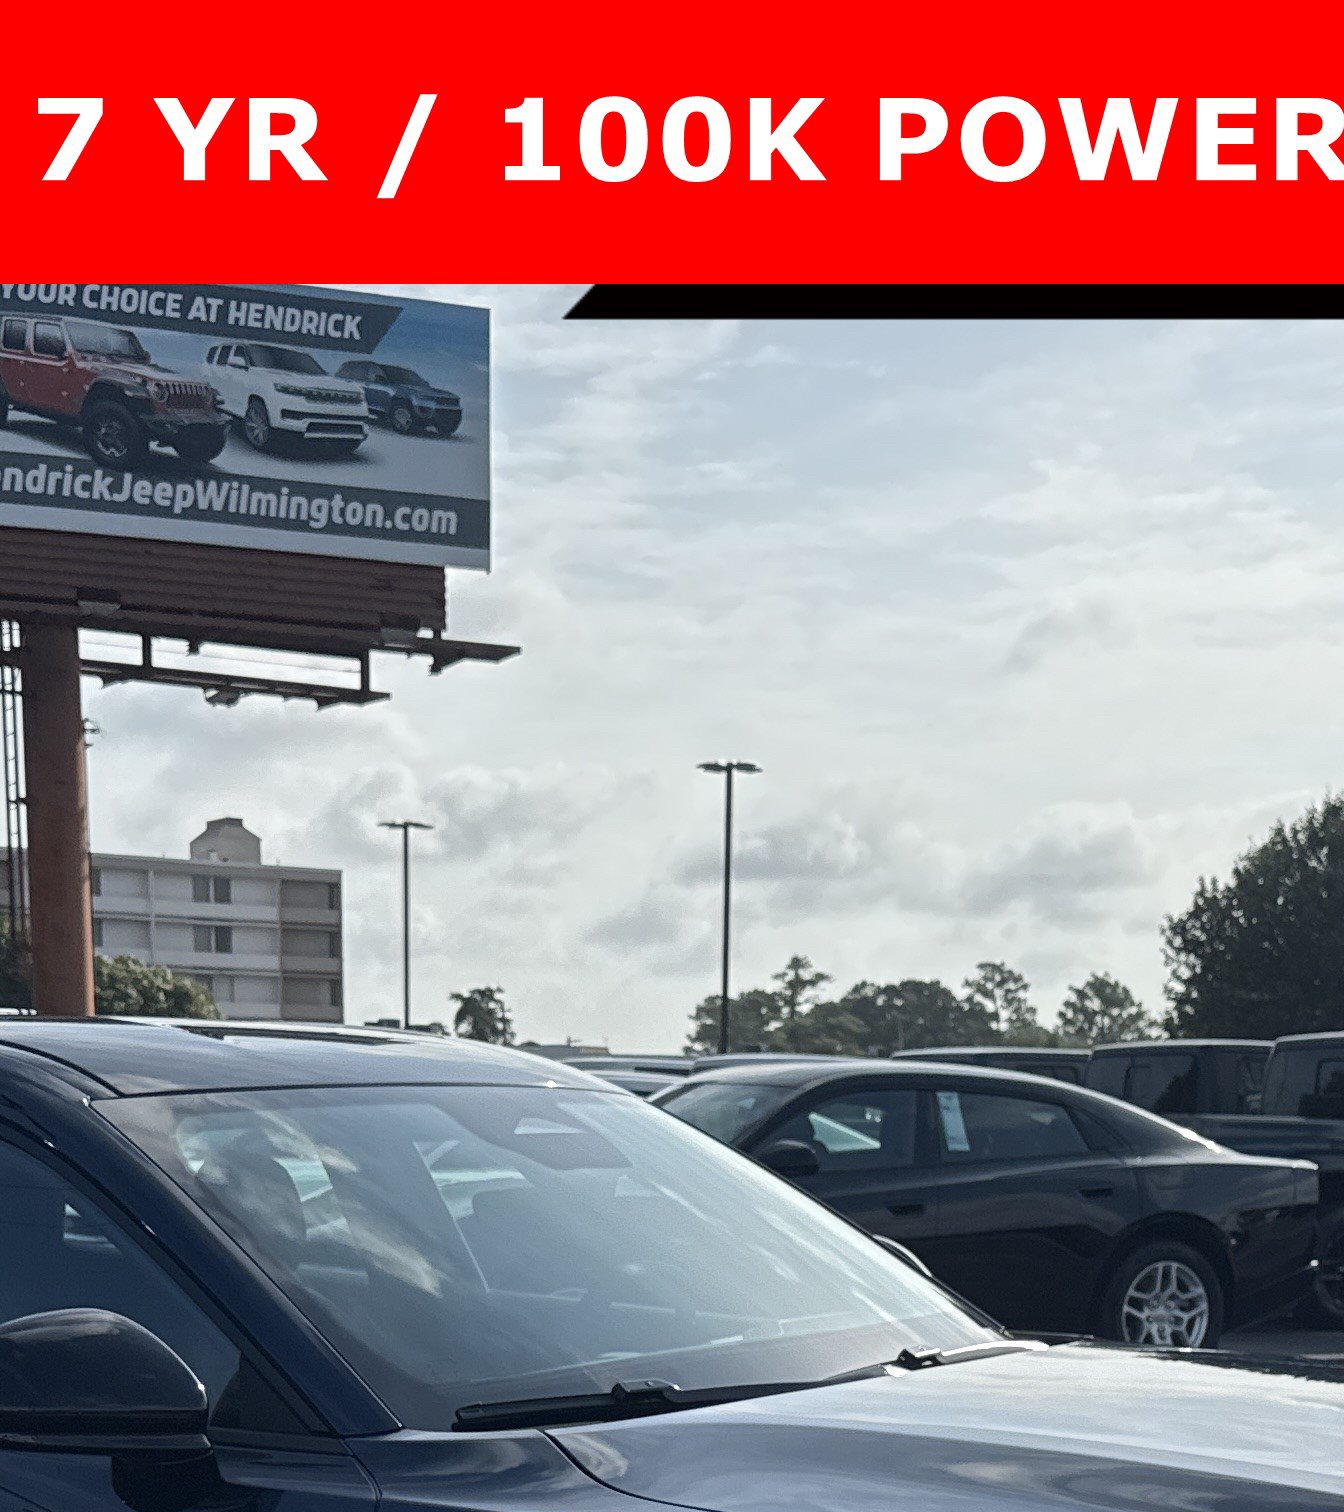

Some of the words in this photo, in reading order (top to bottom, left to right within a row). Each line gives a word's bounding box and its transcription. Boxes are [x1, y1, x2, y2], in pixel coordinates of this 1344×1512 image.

[1, 284, 75, 306] YOUR
[82, 285, 183, 319] CHOICE
[187, 295, 224, 323] AT
[227, 301, 363, 340] HENDRICK
